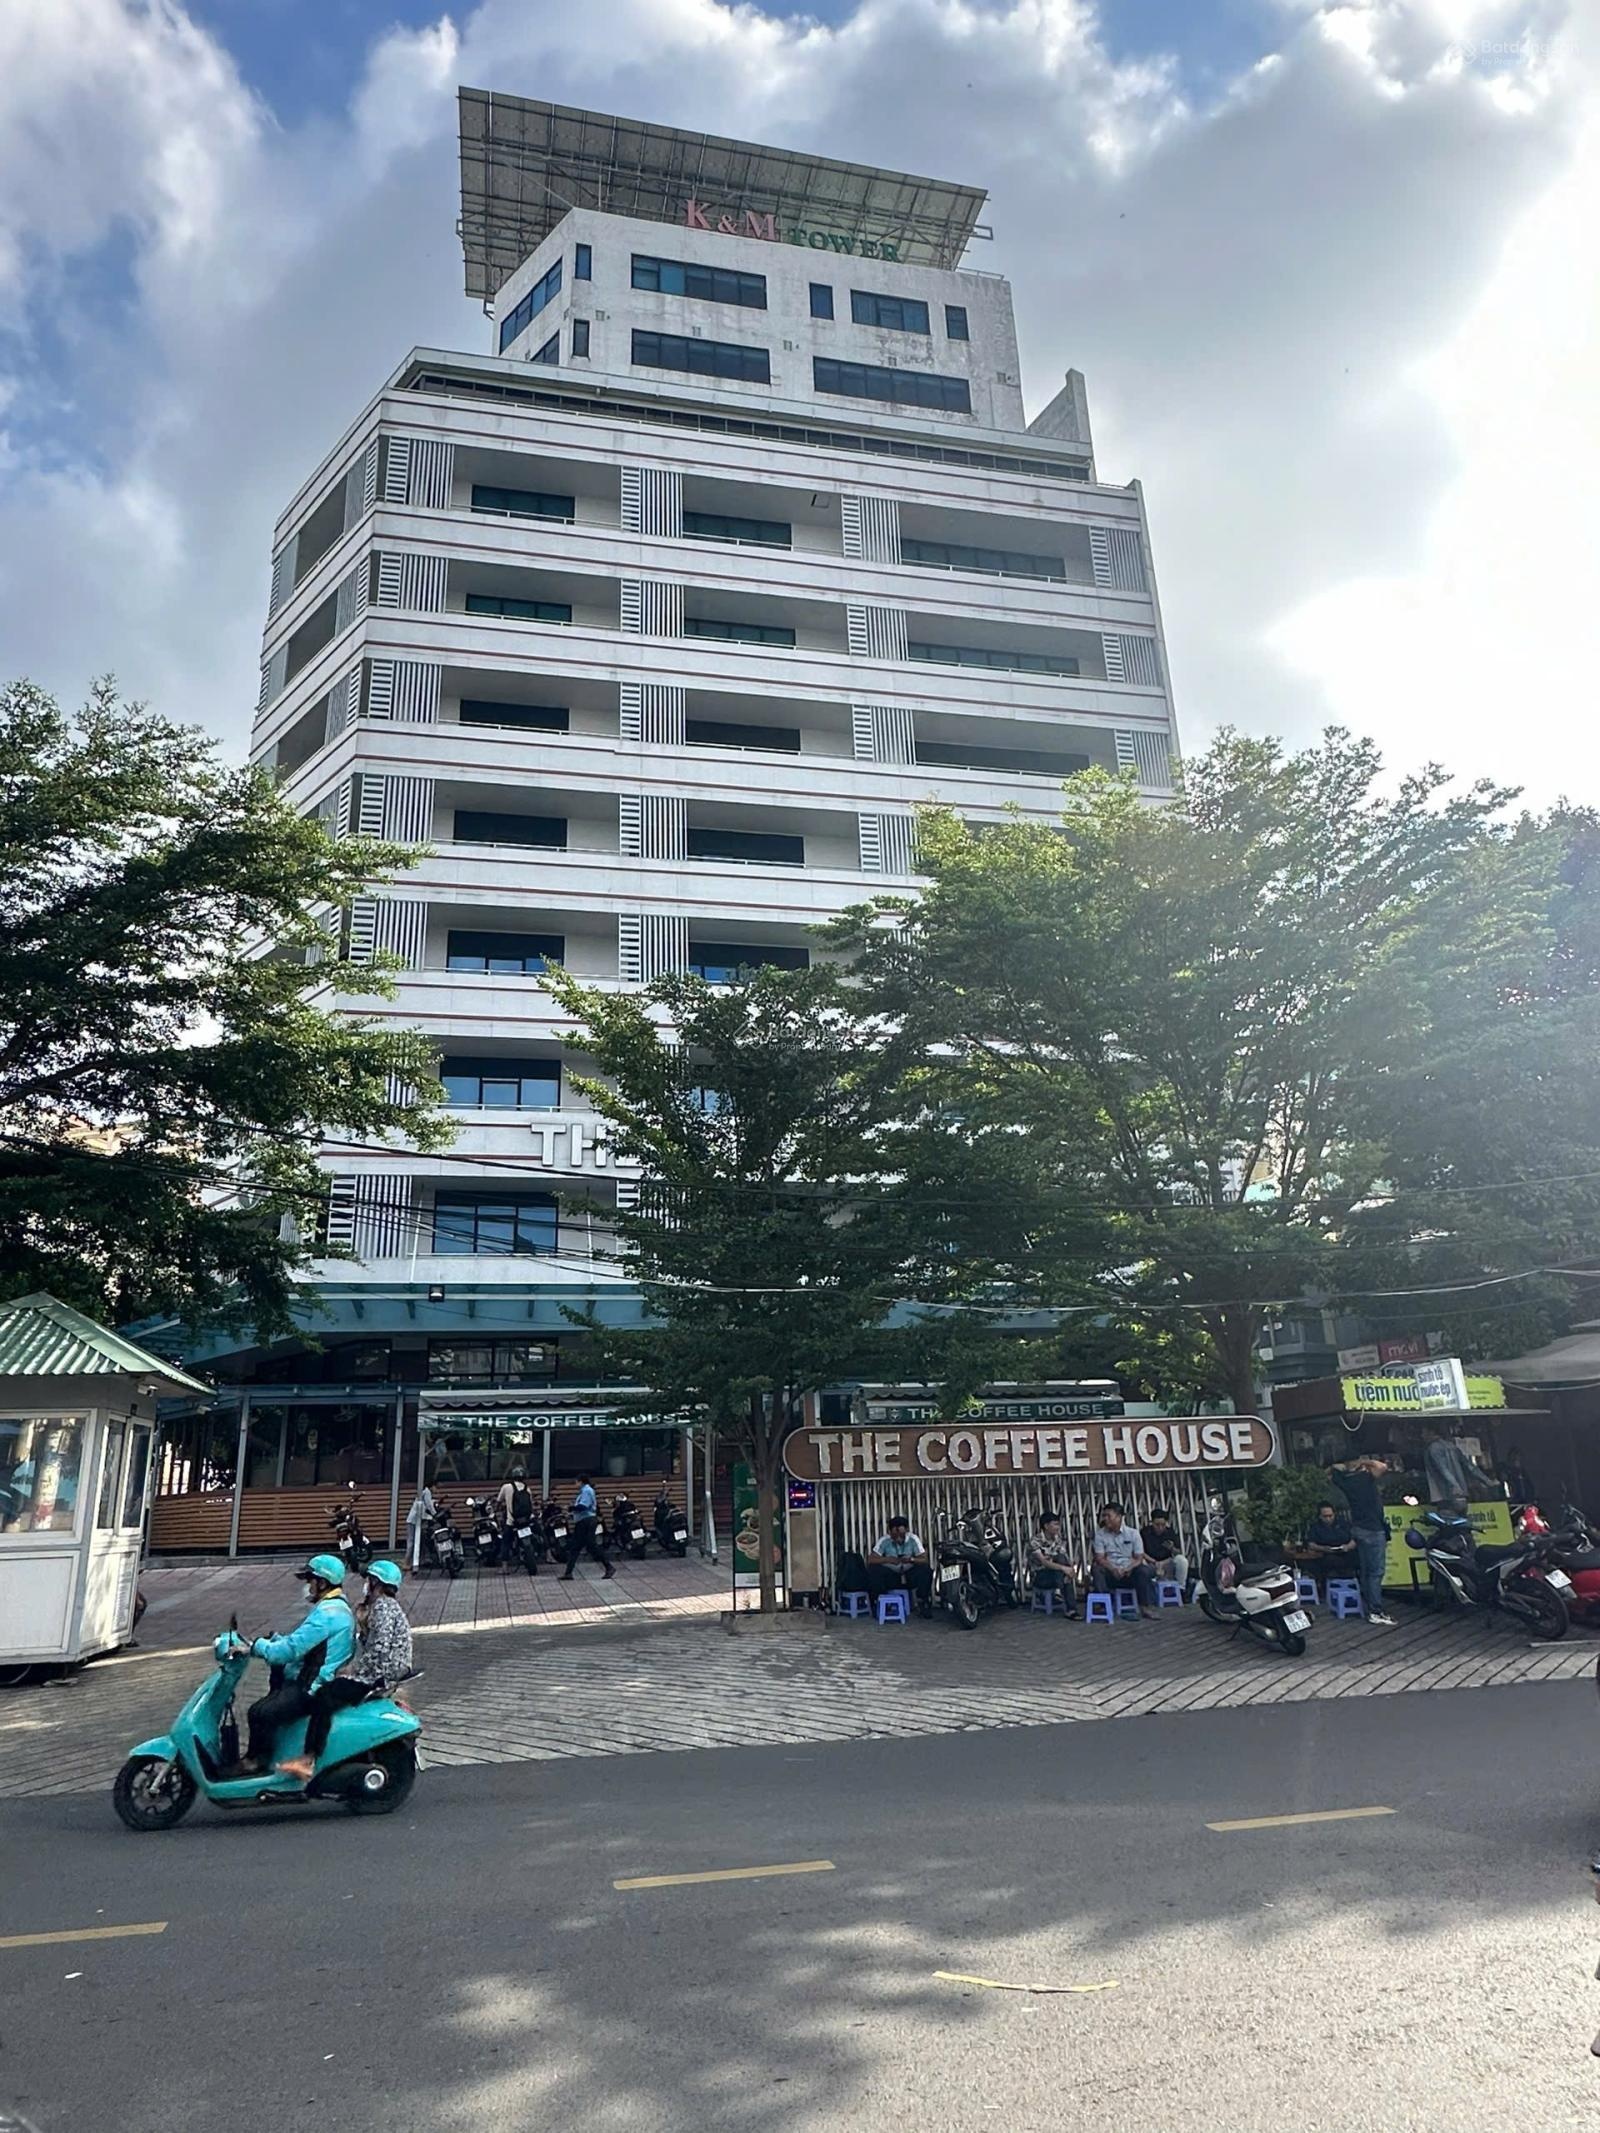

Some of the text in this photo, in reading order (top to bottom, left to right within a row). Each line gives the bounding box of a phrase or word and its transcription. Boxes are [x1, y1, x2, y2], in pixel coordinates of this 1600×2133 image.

[788, 227, 902, 264] TOWER
[531, 1123, 642, 1168] TH
[462, 1416, 509, 1428] THE
[516, 1415, 607, 1428] COFFEE
[1038, 1403, 1105, 1416] HOUSE
[808, 1423, 1255, 1474] THE COFFEE HOUSE
